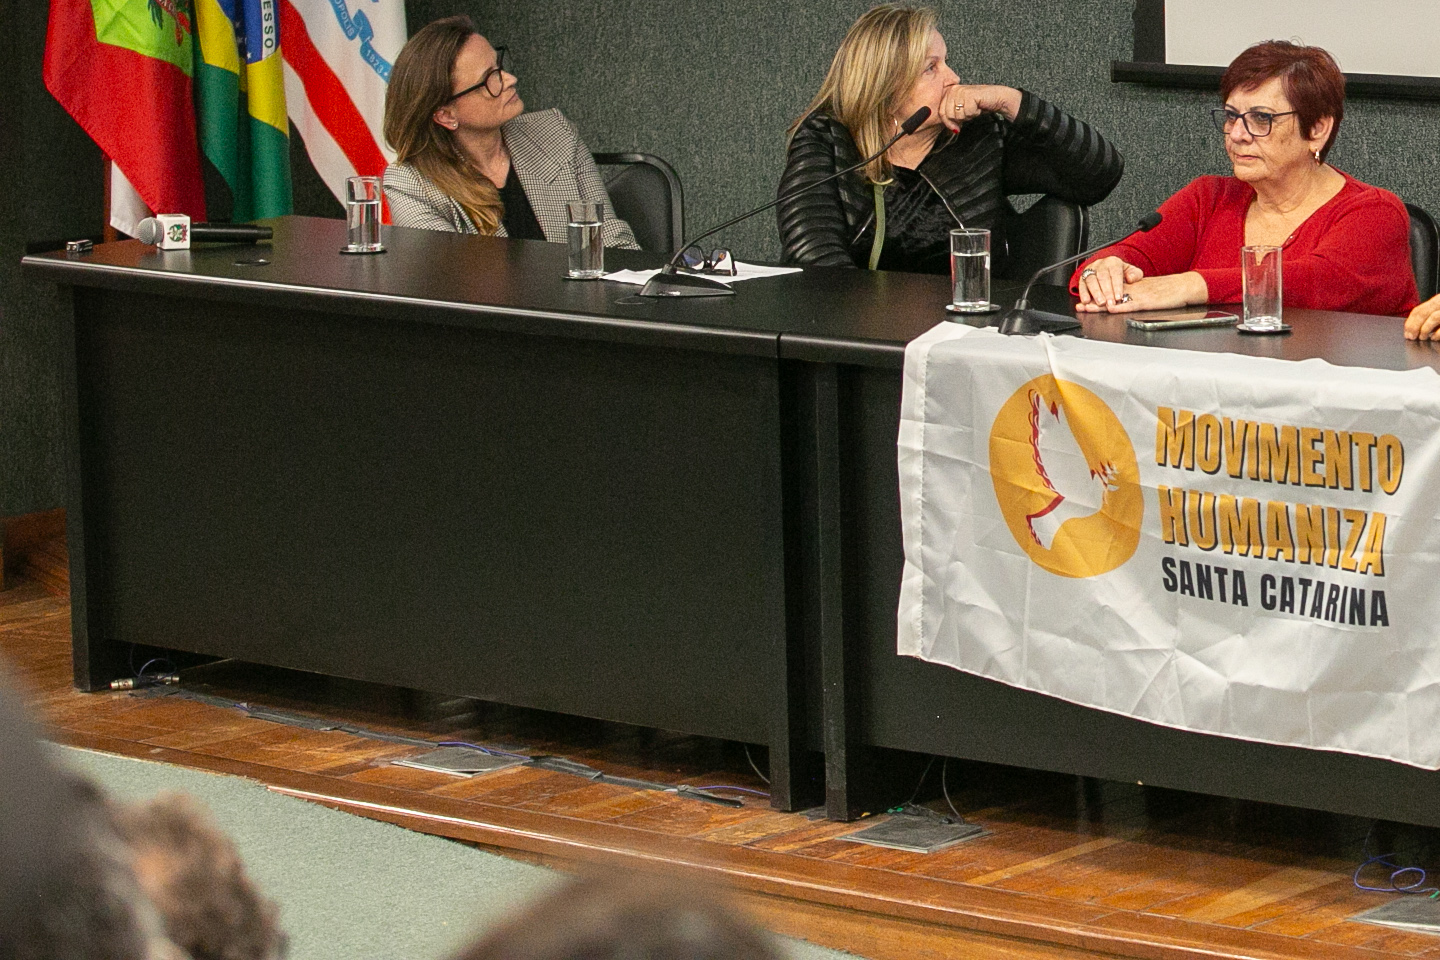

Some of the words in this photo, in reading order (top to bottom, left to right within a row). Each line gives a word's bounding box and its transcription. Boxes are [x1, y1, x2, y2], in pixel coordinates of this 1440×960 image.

[365, 49, 383, 74] 1823
[1155, 405, 1405, 496] MOVIMENTO
[1158, 484, 1387, 577] HUMANIZA
[1161, 556, 1249, 607] SANTA
[1260, 573, 1389, 627] CATARINA
